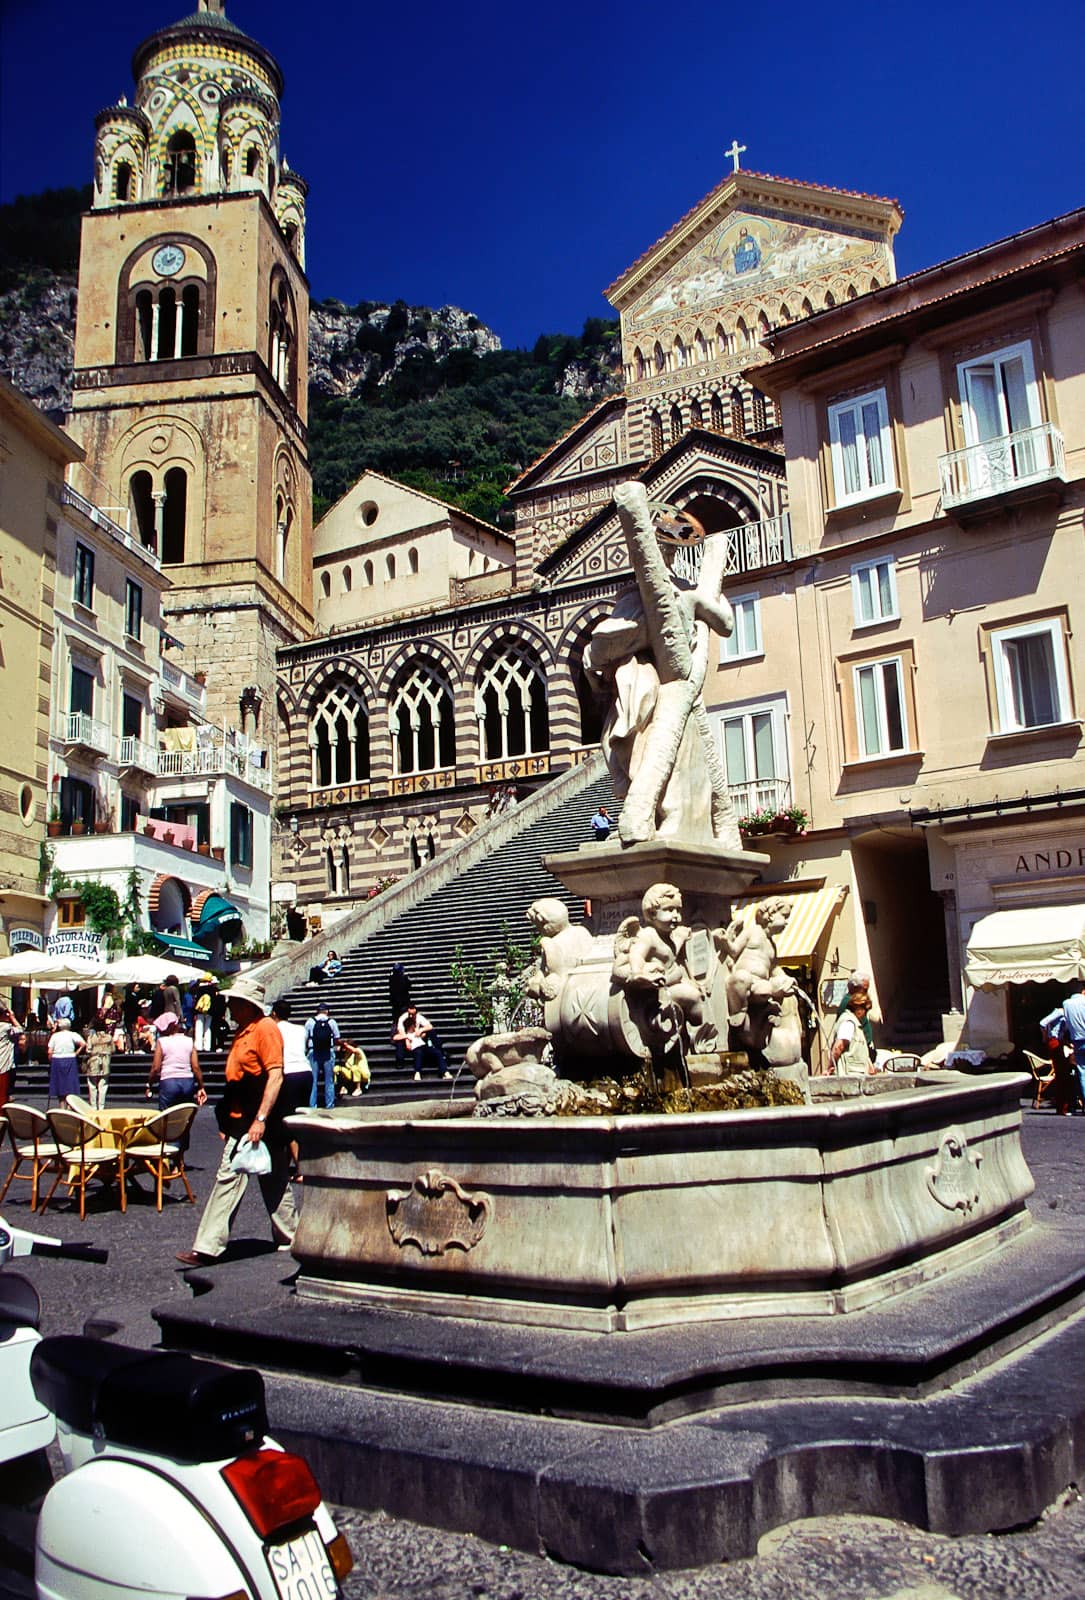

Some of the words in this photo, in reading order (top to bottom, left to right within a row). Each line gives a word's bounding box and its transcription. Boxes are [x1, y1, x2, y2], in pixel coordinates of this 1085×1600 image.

[945, 872, 954, 881] 40
[11, 930, 41, 947] PIZZERIA
[45, 931, 102, 946] RISTORANTE
[48, 943, 99, 957] PIZZERIA
[271, 1541, 302, 1581] SA
